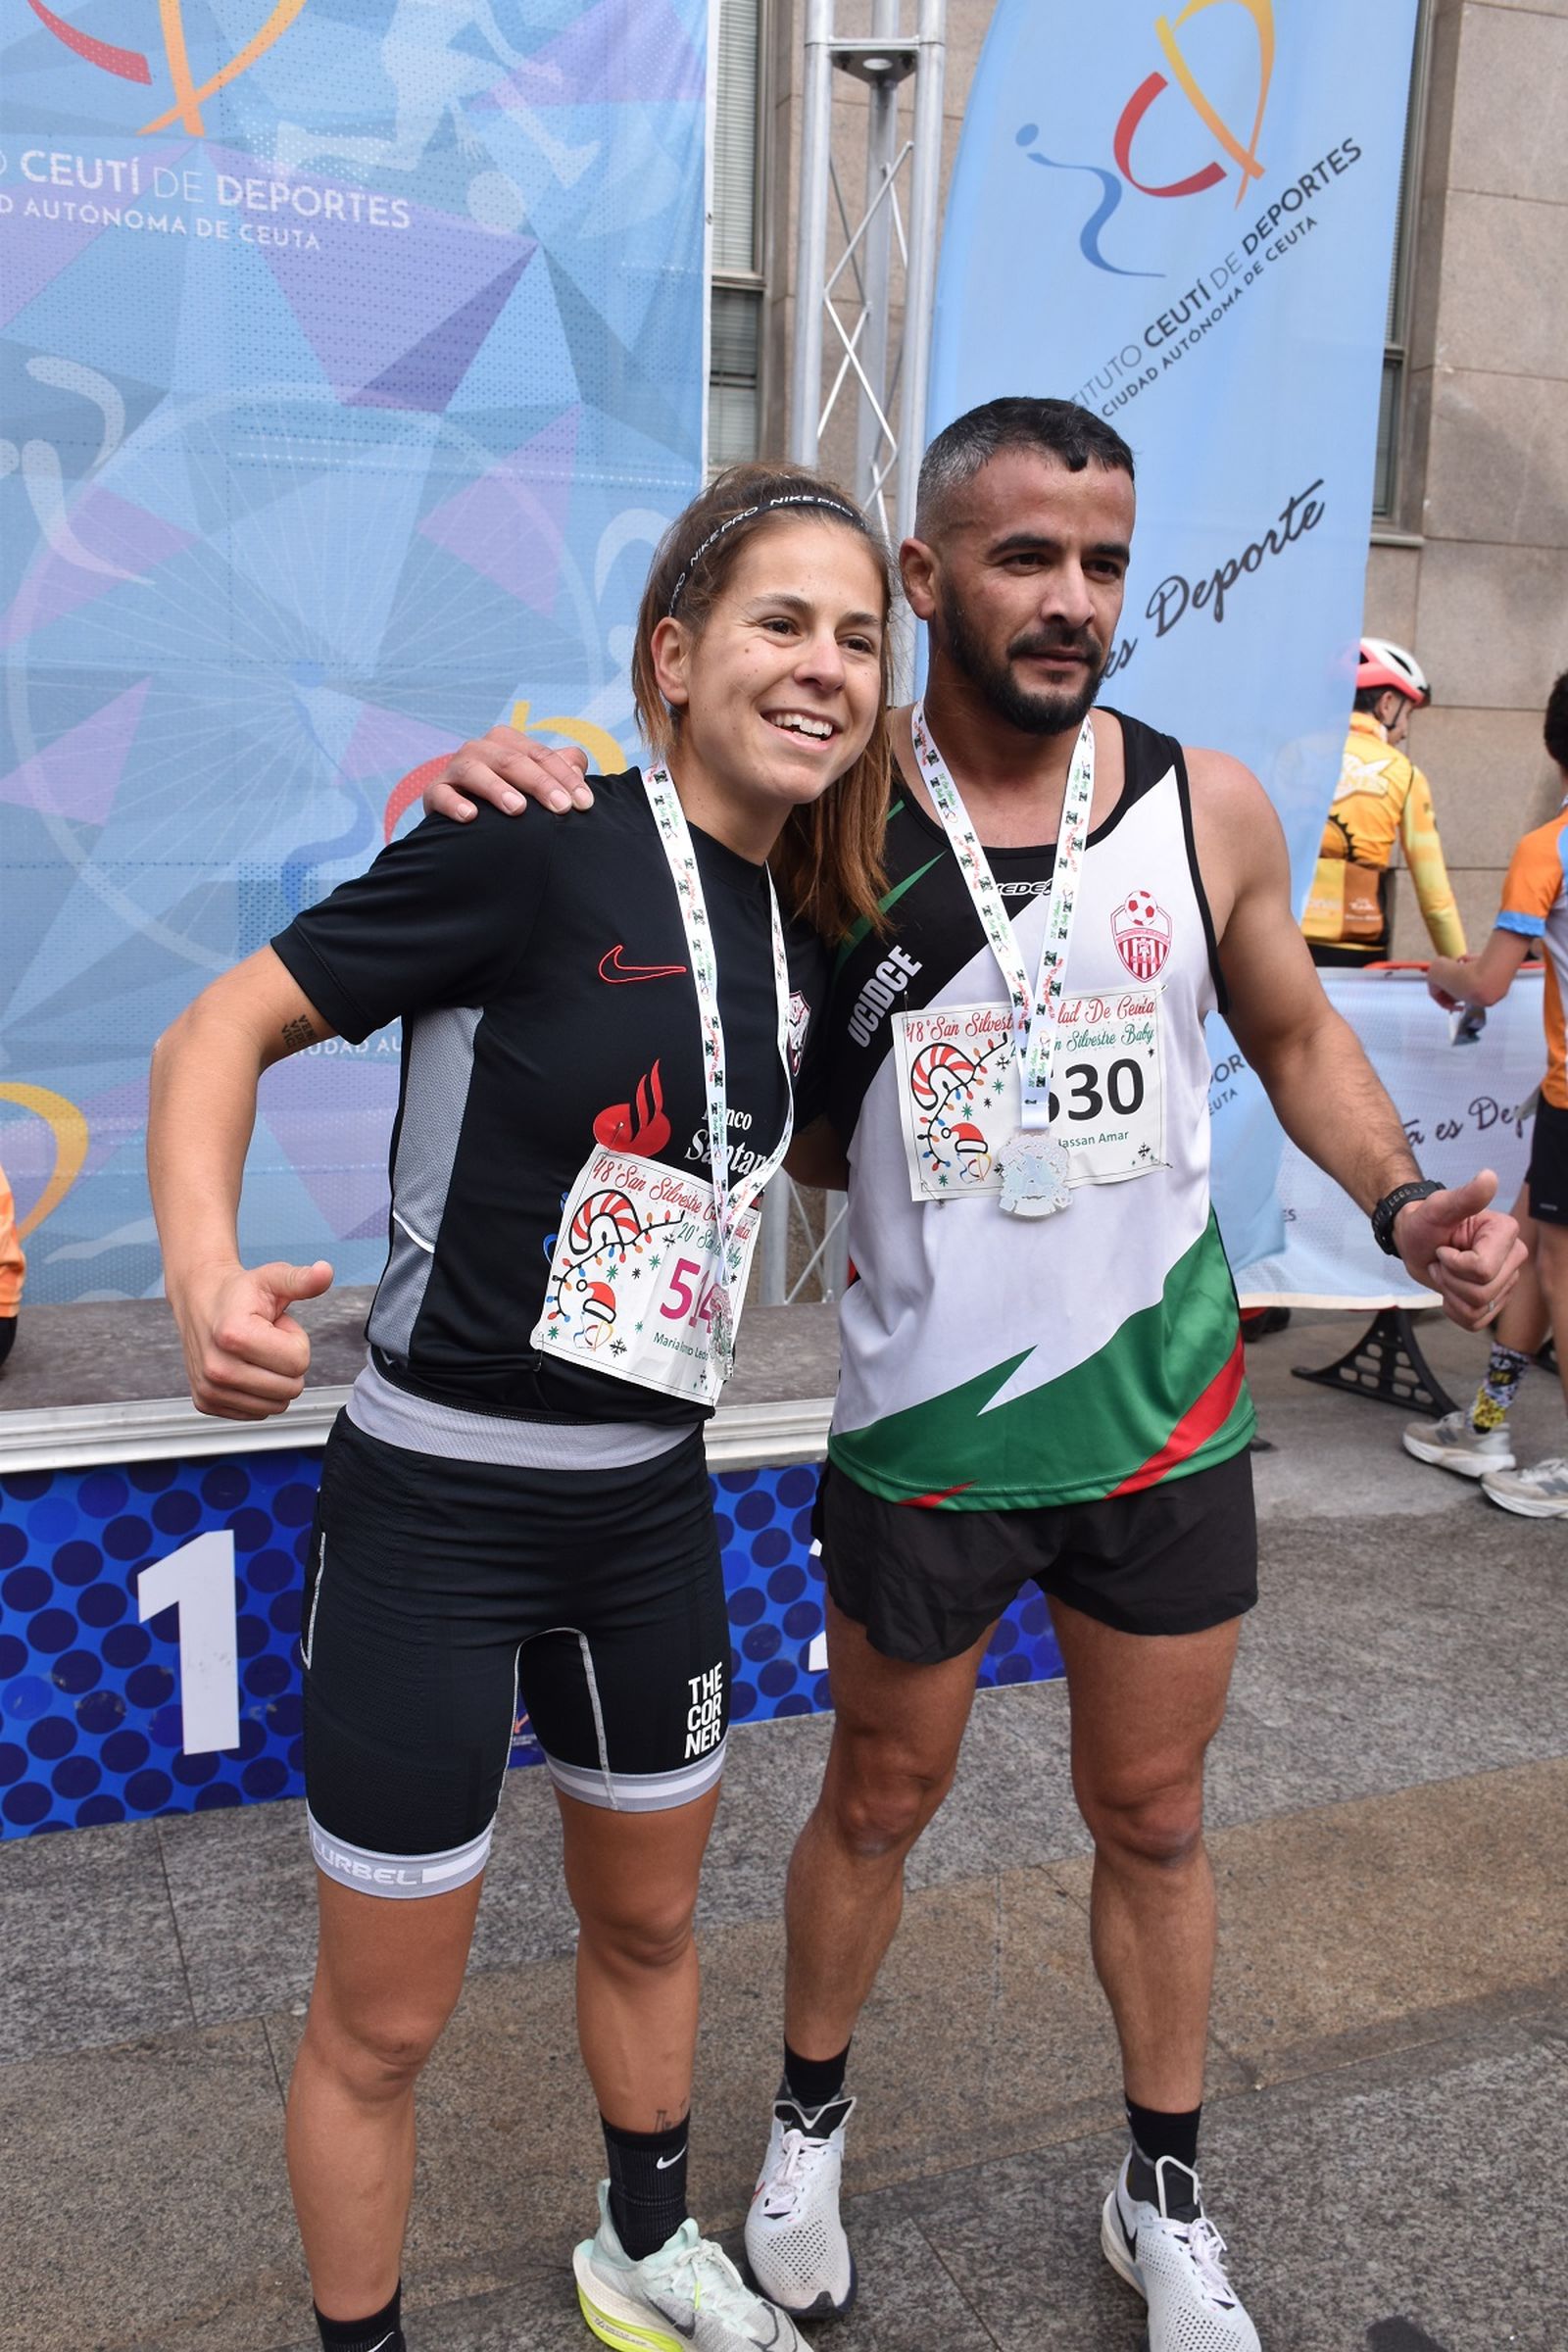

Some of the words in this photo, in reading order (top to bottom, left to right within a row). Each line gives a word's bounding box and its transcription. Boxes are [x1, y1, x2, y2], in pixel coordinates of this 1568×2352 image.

[21, 149, 140, 195] CEUTÍ
[154, 166, 205, 204] DE
[217, 174, 411, 229] DEPORTES
[24, 197, 187, 236] AUTÓNOMA
[196, 218, 229, 239] DE
[239, 223, 321, 252] CEUTA
[1143, 278, 1212, 348] CEUTÍ
[1208, 250, 1244, 291] DE
[1241, 137, 1362, 257] DEPORTES
[1102, 368, 1158, 417] CIUDAD
[1162, 286, 1243, 370] AUTÓNOMA
[1243, 260, 1265, 286] DE
[1264, 216, 1318, 263] CEUTA
[690, 529, 720, 566] NIKE
[721, 506, 760, 533] PRO
[769, 495, 814, 506] NIKE
[1145, 478, 1326, 639] Deporte
[848, 945, 923, 1048] UCIDCE
[930, 1015, 959, 1041] San
[1084, 998, 1110, 1024] De
[1117, 995, 1155, 1020] Ceuta
[1066, 1029, 1116, 1053] Silvestre
[1120, 1021, 1153, 1046] Baby
[1049, 1058, 1145, 1124] 30
[1098, 1131, 1129, 1145] Amar
[1436, 1119, 1464, 1141] es
[614, 1164, 647, 1193] San
[649, 1177, 704, 1213] Silvestre
[137, 1529, 240, 1756] 1
[688, 1661, 723, 1704] THE
[684, 1718, 721, 1759] NER
[687, 1691, 722, 1732] COR
